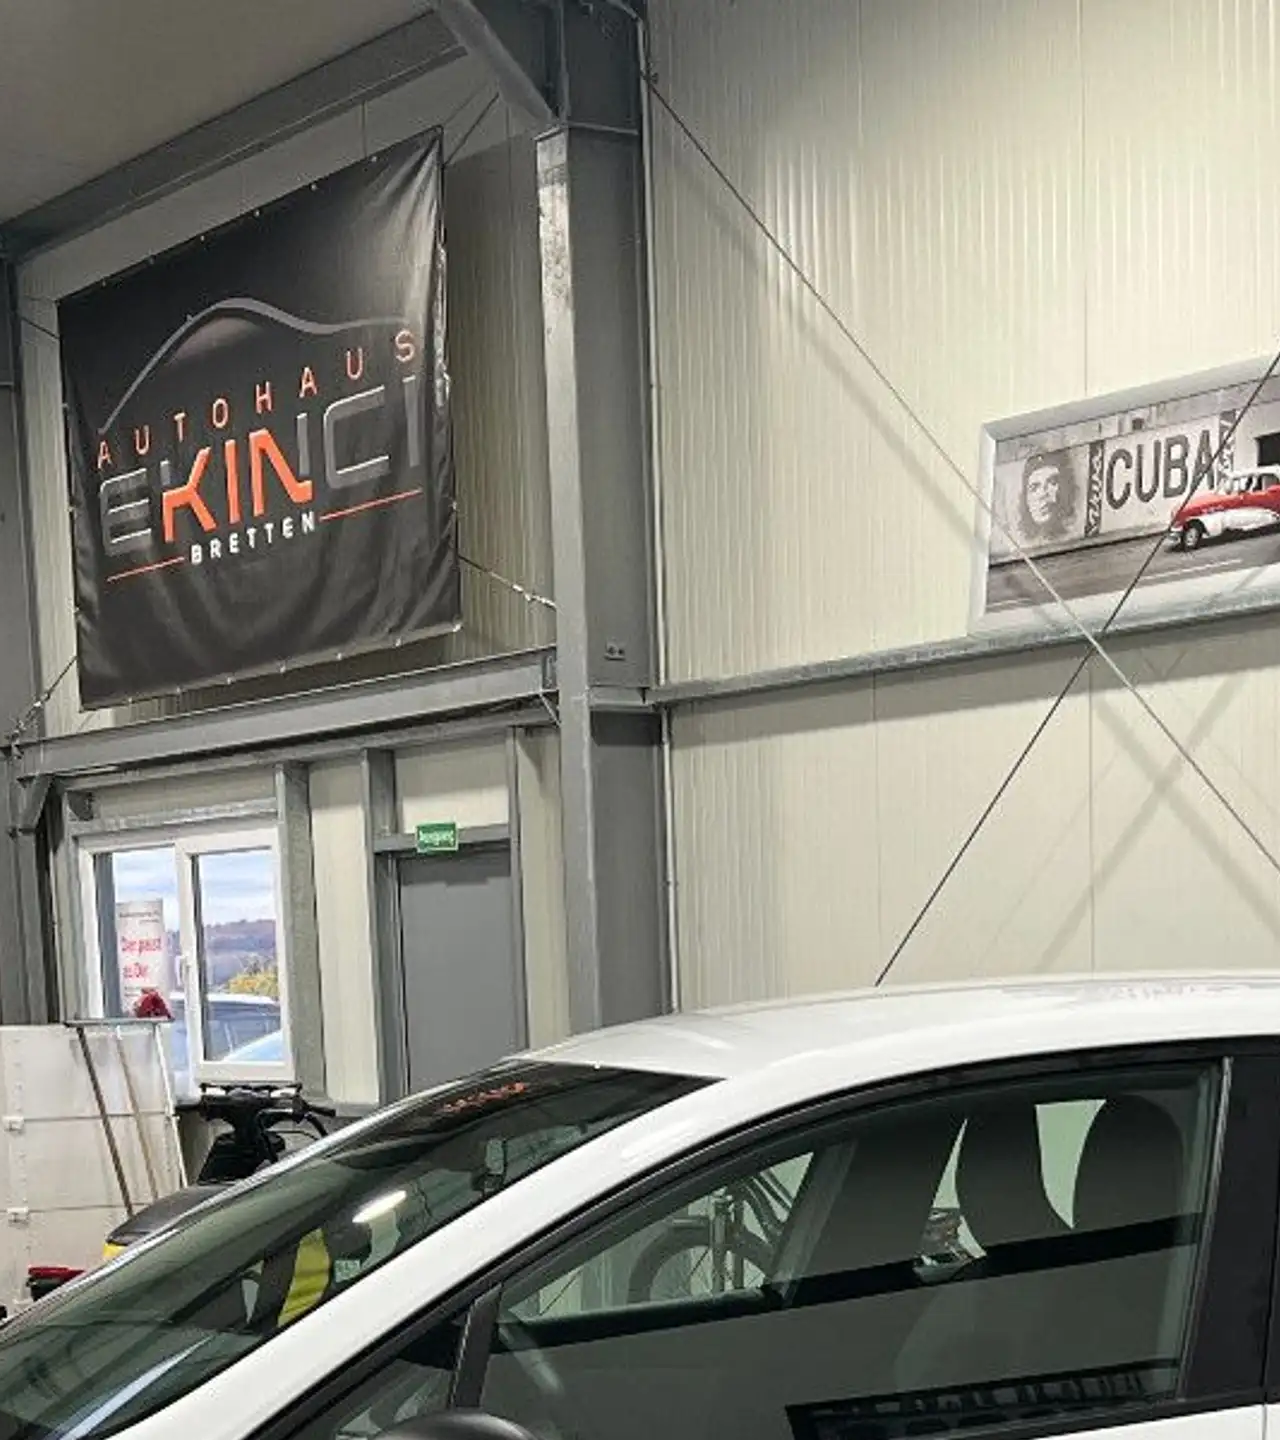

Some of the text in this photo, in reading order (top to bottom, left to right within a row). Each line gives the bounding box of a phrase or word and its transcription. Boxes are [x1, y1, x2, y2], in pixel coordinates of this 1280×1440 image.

[96, 329, 416, 470] AUTOHAUS
[99, 374, 422, 556] EKINCI
[1105, 429, 1215, 510] CUBA
[190, 511, 315, 565] BRETTEN
